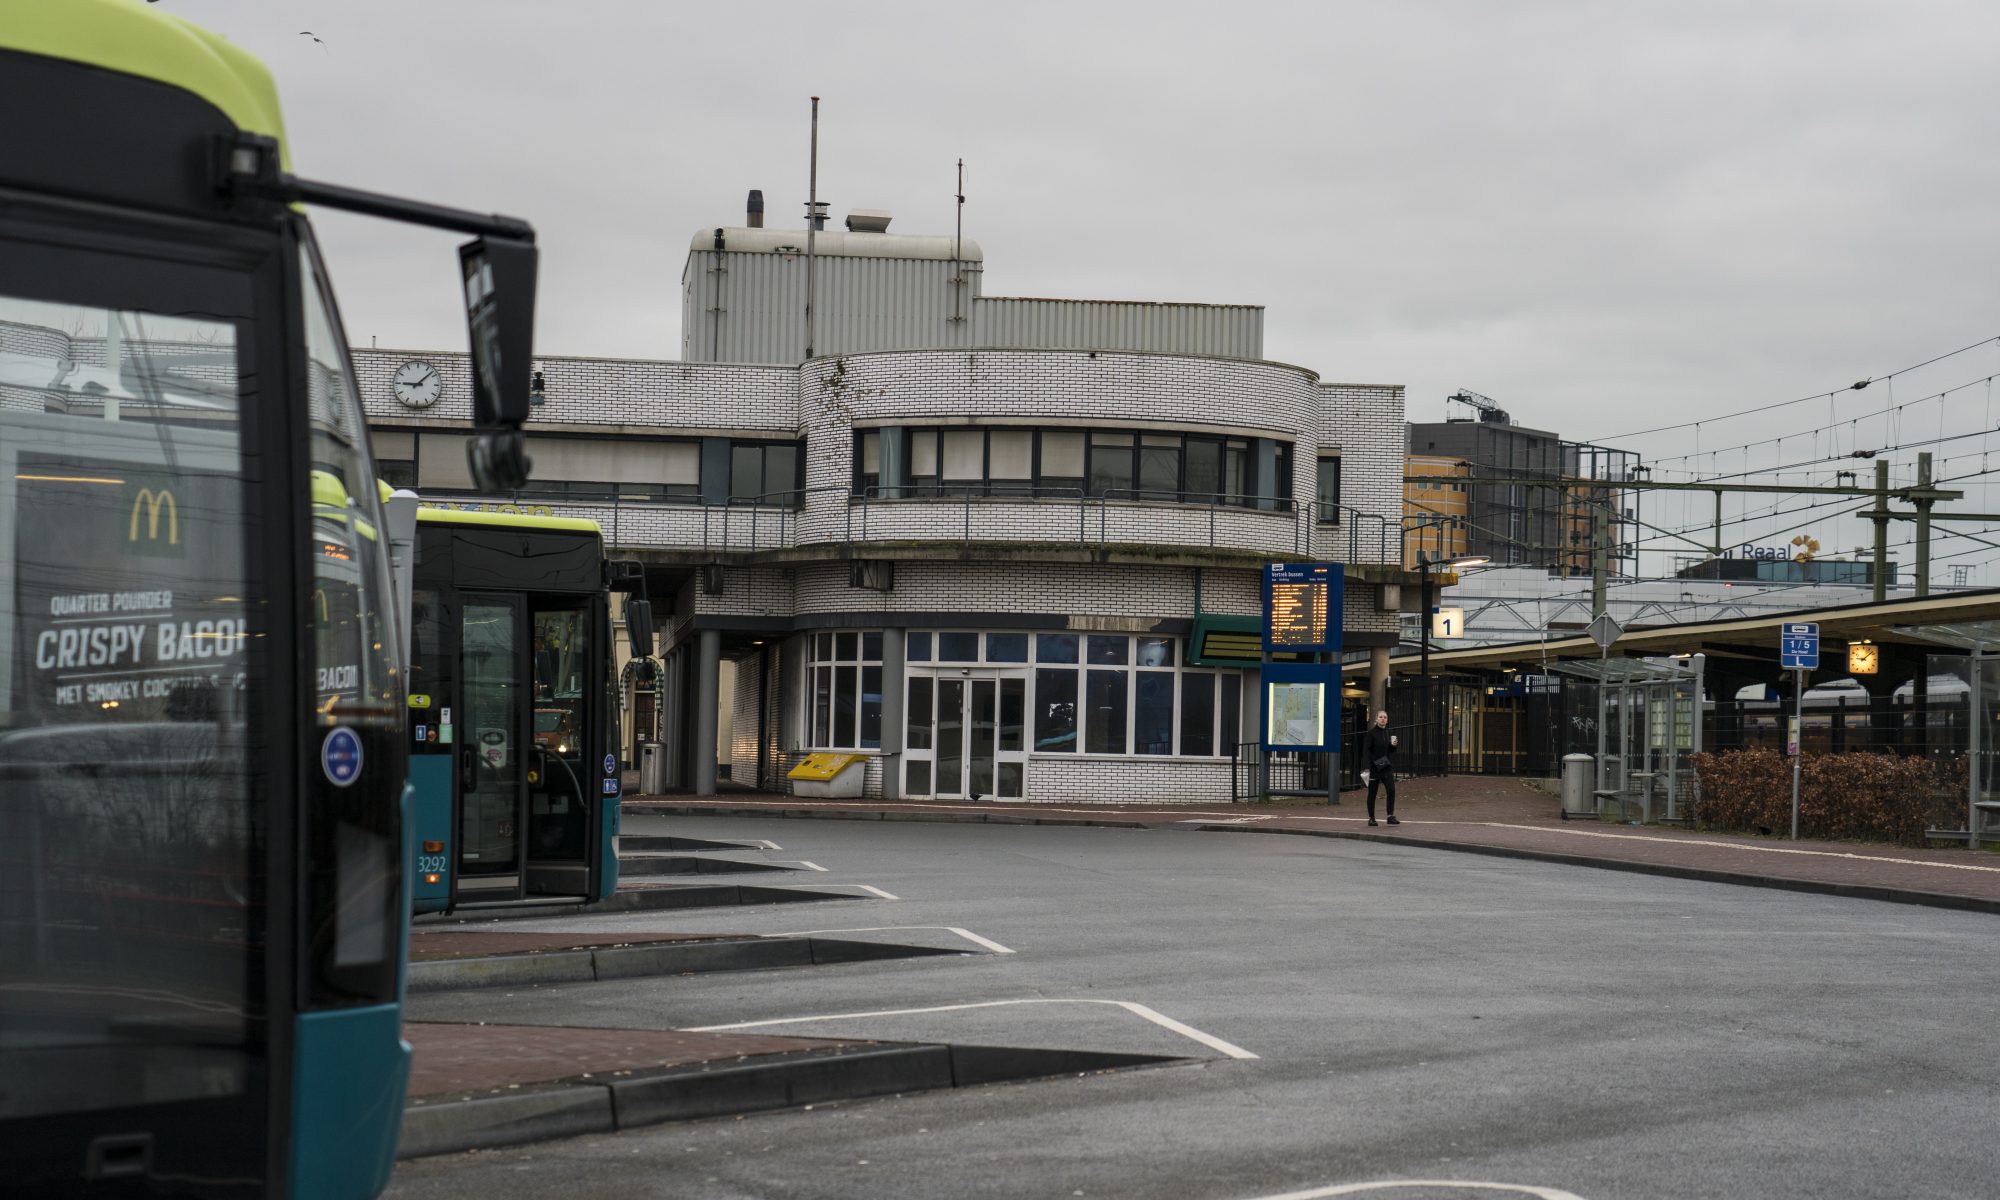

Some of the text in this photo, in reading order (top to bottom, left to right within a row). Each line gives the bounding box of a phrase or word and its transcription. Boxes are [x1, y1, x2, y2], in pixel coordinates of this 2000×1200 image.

[1742, 543, 1791, 560] Reaal
[51, 590, 173, 616] QUARTER POUNDER
[1442, 618, 1451, 636] 1
[35, 624, 145, 670] CRISPY
[1790, 640, 1795, 649] 1
[1804, 641, 1810, 649] 5
[1796, 656, 1803, 666] L
[56, 684, 83, 705] MET
[86, 679, 141, 702] SMOKEY
[418, 856, 446, 873] 3292
